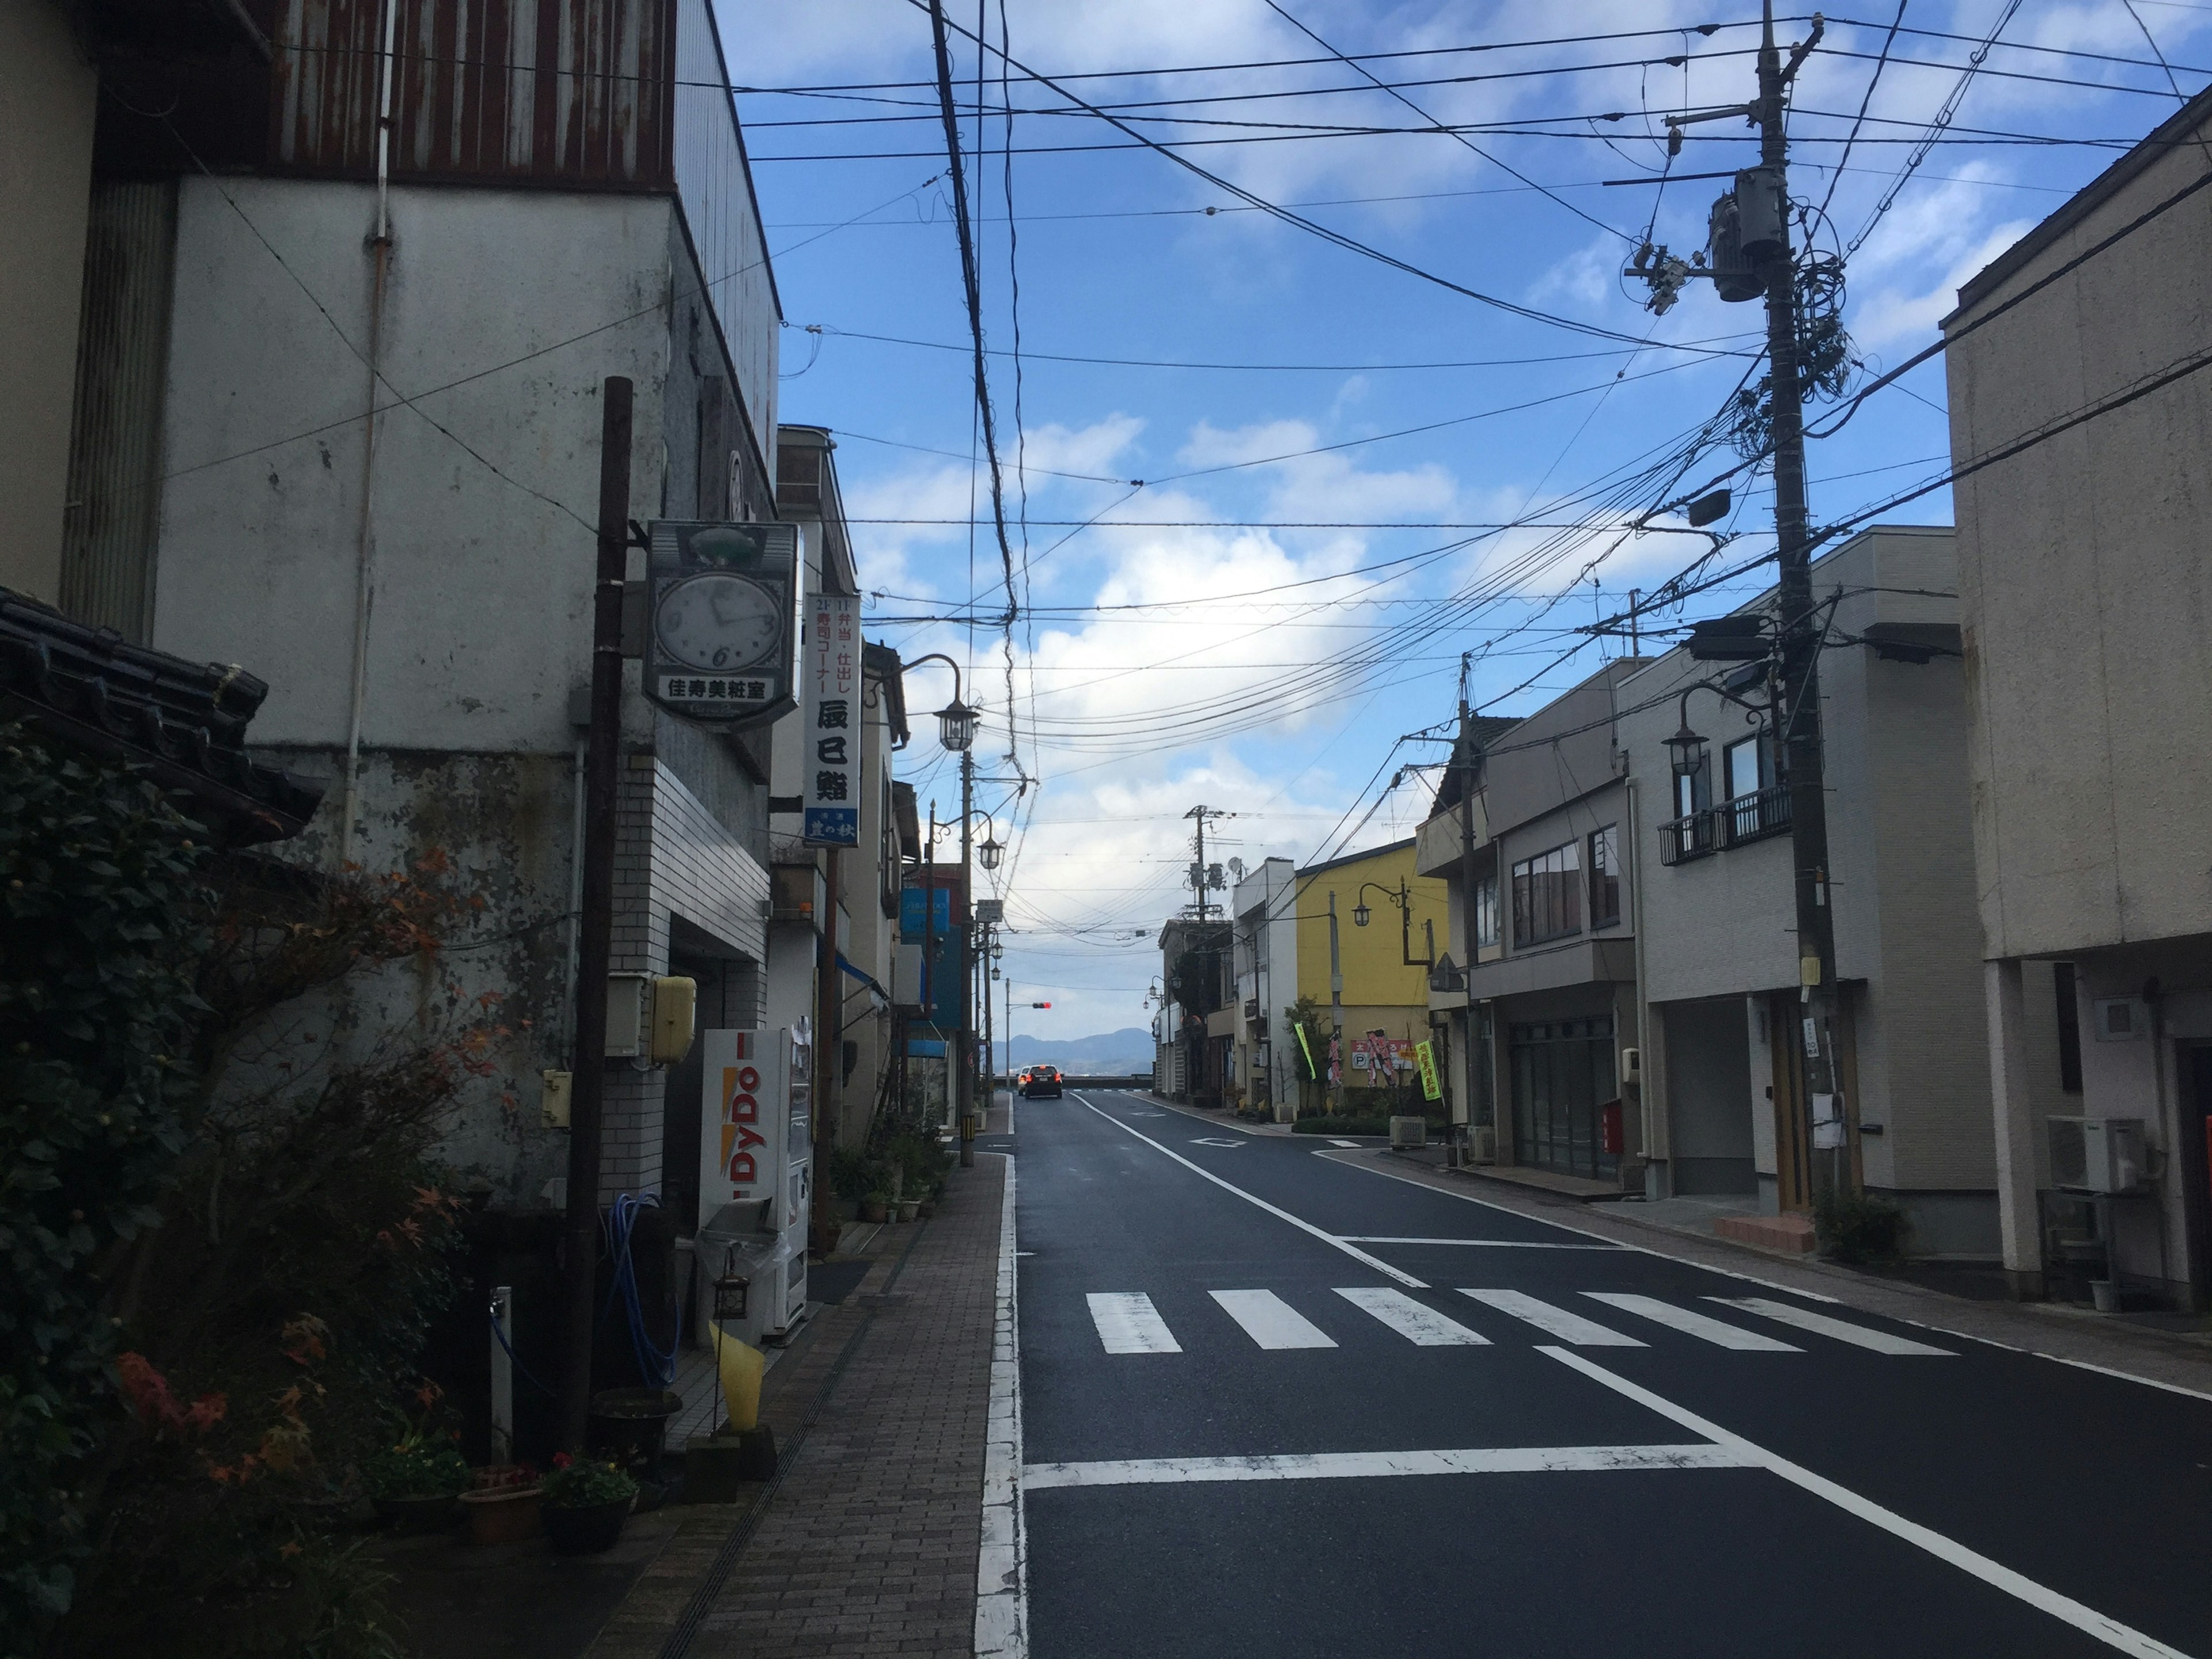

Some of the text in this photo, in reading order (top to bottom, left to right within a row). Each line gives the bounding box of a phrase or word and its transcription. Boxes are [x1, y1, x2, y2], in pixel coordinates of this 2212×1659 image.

[816, 600, 831, 694] 2F 寿司コーナー
[837, 600, 851, 694] 1F 弁当・仕出し
[730, 1066, 766, 1181] DyDo
